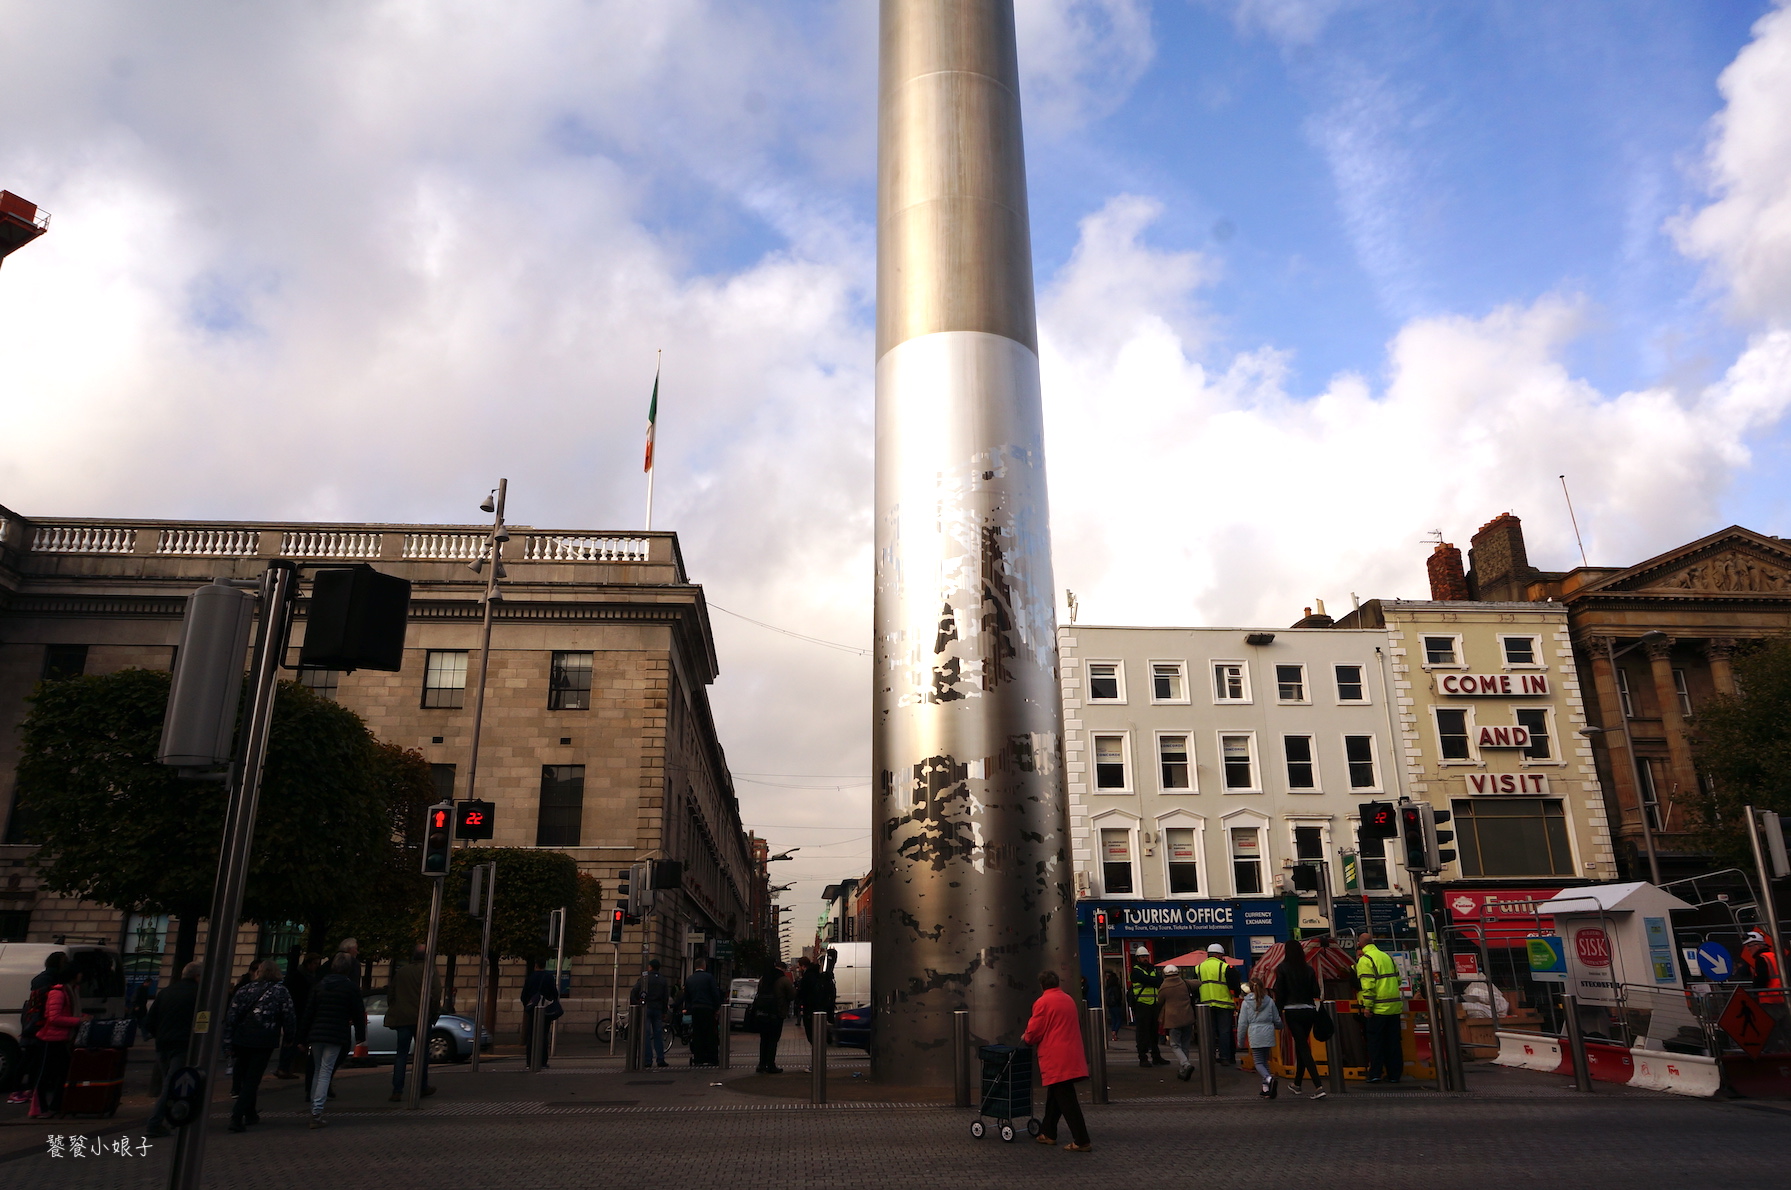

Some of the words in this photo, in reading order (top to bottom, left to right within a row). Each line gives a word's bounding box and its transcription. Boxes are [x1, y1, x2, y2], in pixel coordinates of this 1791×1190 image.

[1443, 675, 1512, 694] COME
[1521, 675, 1547, 694] IN
[1479, 727, 1528, 746] AND
[1469, 774, 1544, 793] VISIT
[466, 812, 483, 825] 22
[1484, 895, 1536, 914] Funl
[1123, 908, 1183, 924] TOURISM
[1186, 907, 1234, 924] OFFICE
[1578, 938, 1608, 957] SISK
